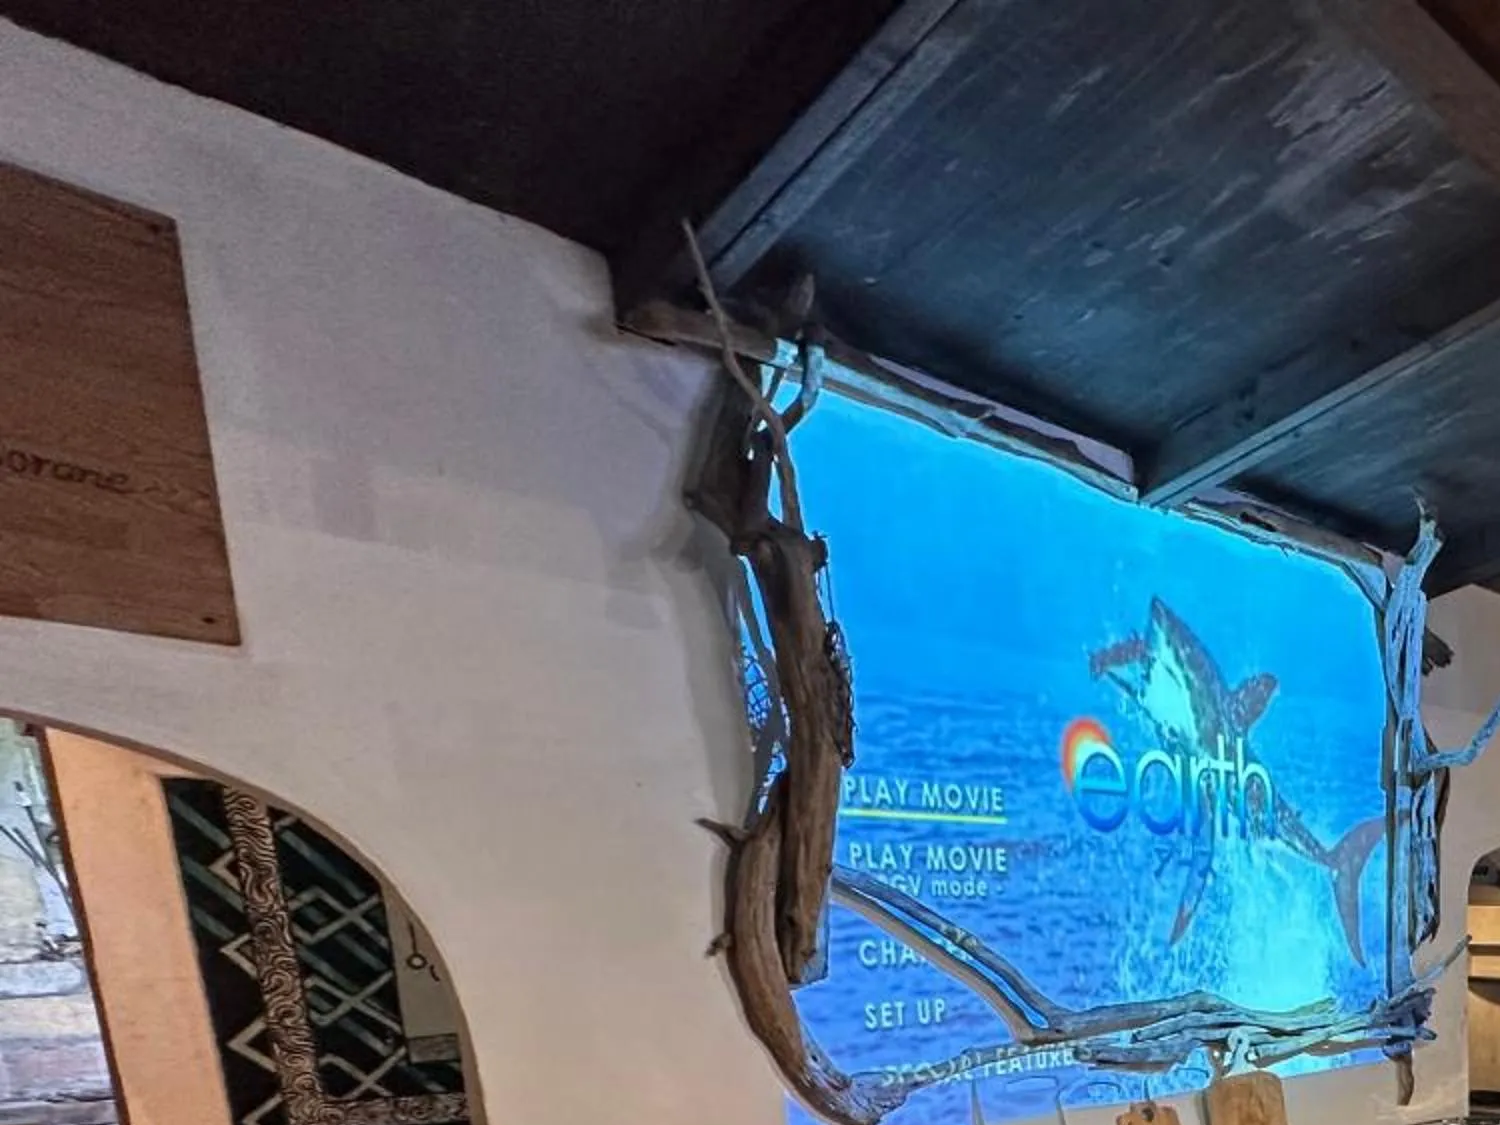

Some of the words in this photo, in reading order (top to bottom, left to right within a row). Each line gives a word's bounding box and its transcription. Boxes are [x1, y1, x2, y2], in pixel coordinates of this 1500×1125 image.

[843, 775, 909, 806] PLAY
[921, 781, 1004, 812] MOVIE
[1071, 733, 1275, 840] earth
[849, 842, 913, 870] PLAY
[927, 845, 1008, 872] MOVIE
[931, 874, 988, 897] mode
[864, 1000, 905, 1029] SET
[916, 997, 946, 1025] UP
